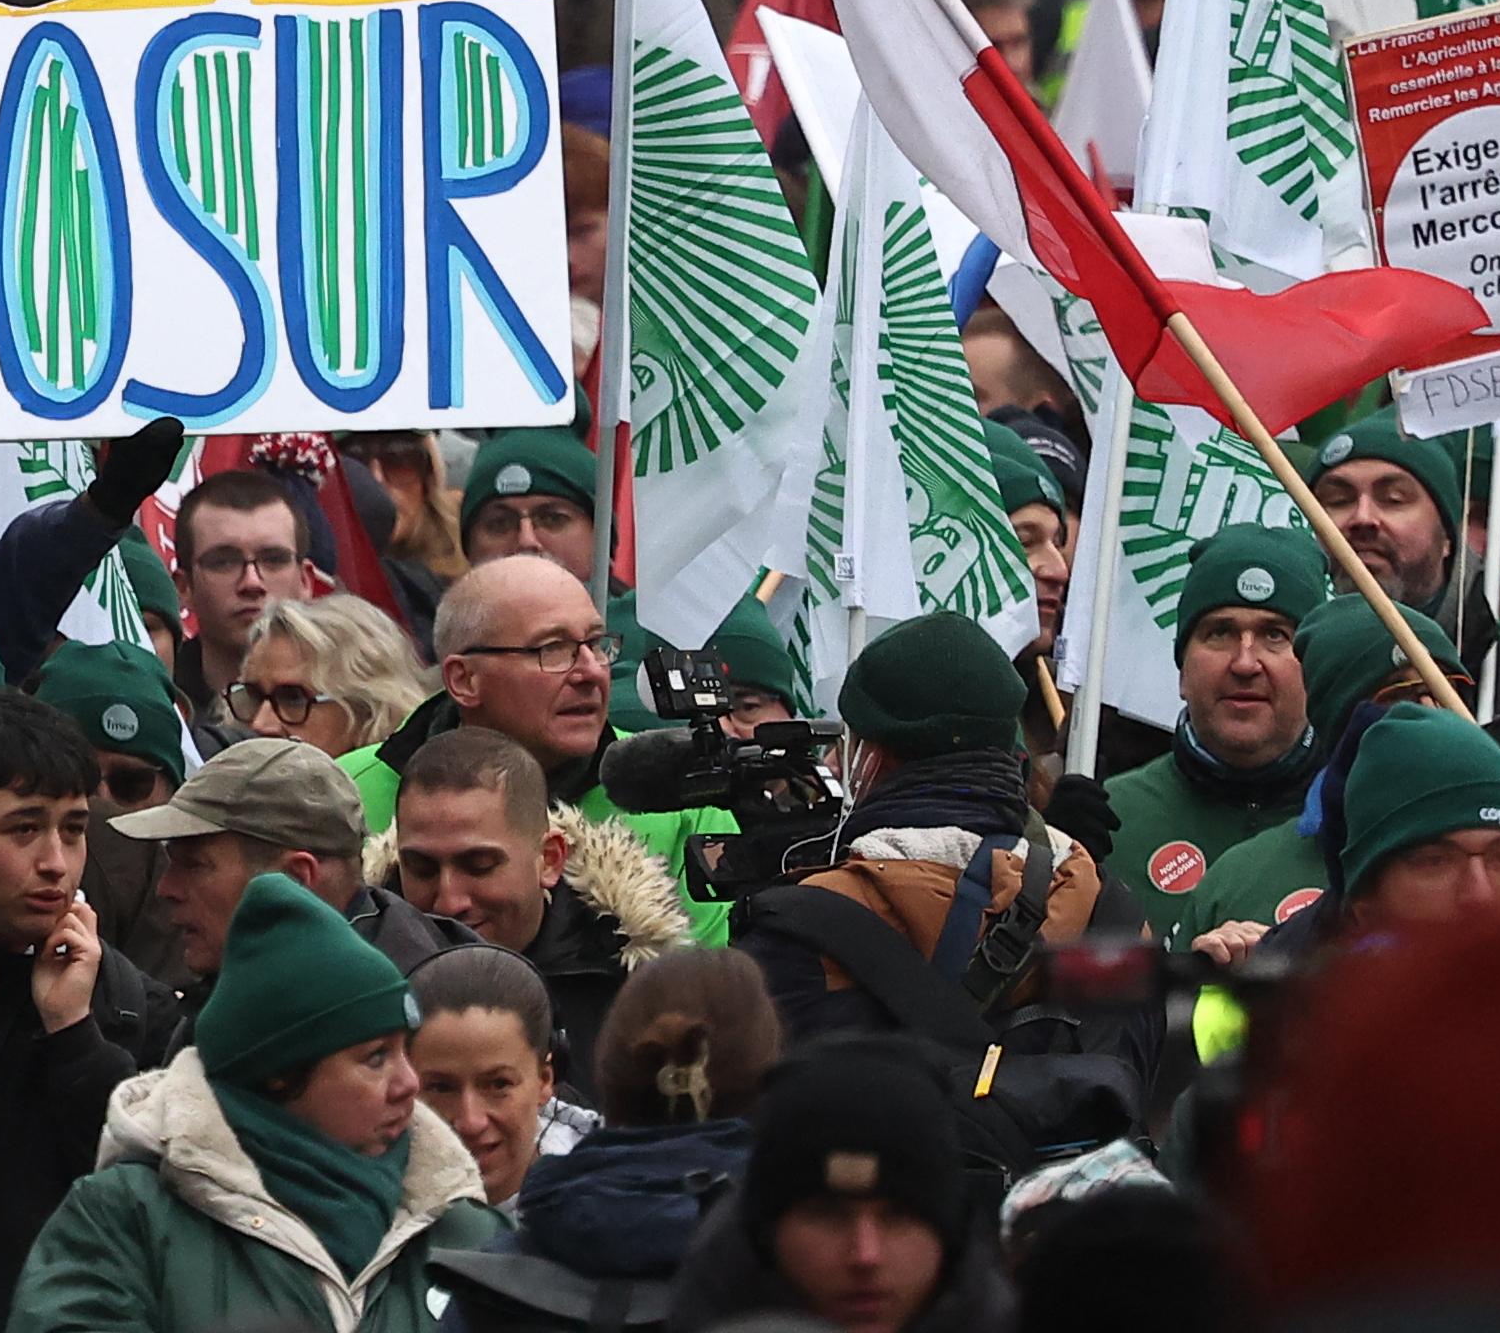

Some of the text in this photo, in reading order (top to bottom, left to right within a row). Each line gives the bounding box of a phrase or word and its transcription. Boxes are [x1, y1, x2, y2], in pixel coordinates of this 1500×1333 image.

[1390, 66, 1475, 96] essentielle
[1478, 60, 1488, 75] à
[1368, 94, 1453, 124] Remerciez
[1454, 88, 1479, 104] les
